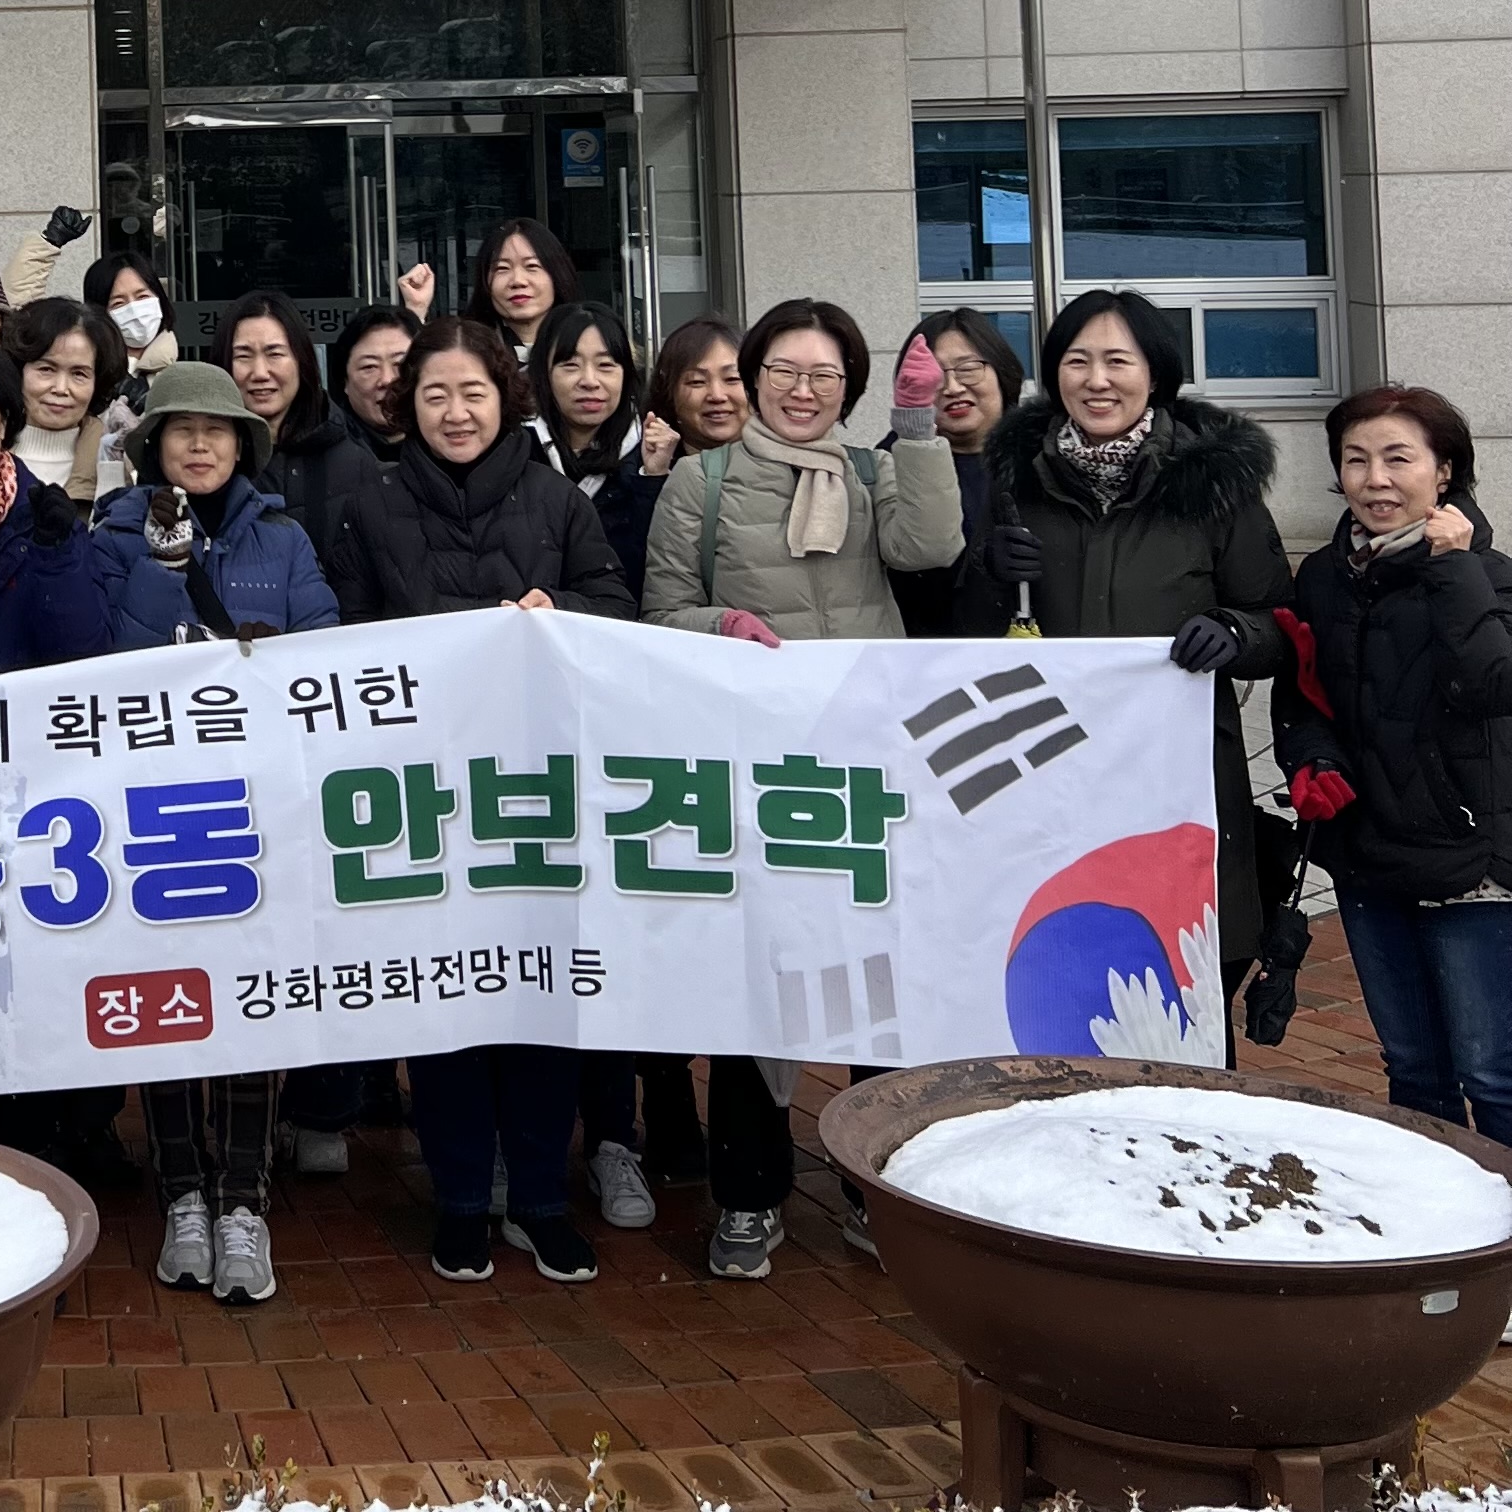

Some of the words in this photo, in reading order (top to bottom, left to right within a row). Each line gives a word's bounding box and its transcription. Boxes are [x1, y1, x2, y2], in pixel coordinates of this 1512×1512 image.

[46, 684, 249, 758] 확립을
[286, 663, 419, 734] 위한
[321, 752, 906, 905] 안보견학
[235, 945, 554, 1020] 강화평화전망대
[569, 947, 607, 997] 등
